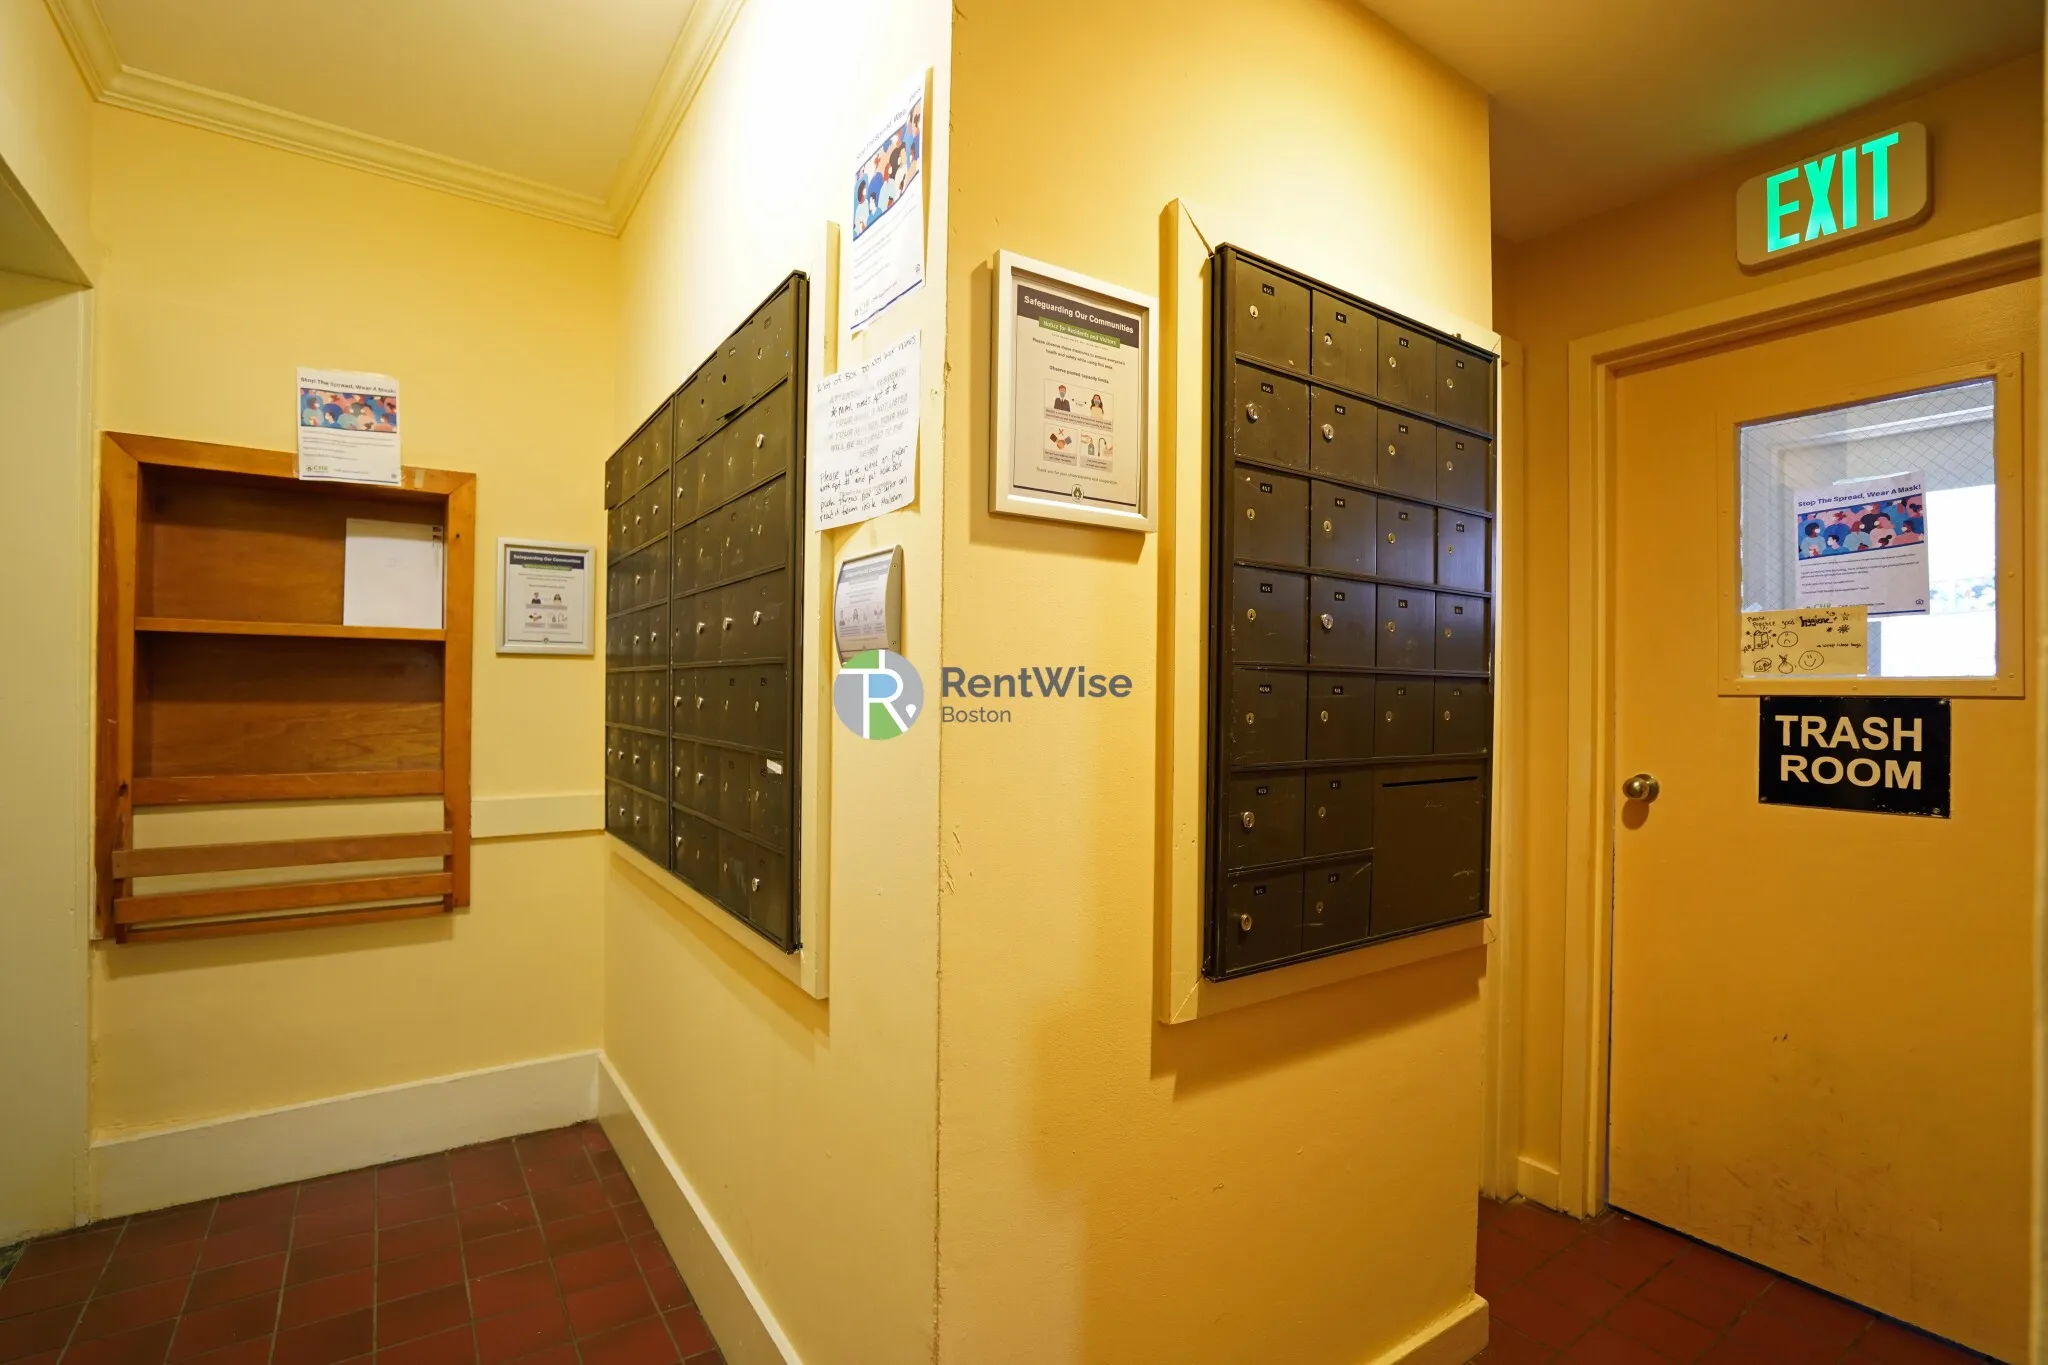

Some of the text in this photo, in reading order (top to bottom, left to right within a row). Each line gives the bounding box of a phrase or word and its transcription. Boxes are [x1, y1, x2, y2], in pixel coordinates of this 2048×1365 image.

[1767, 132, 1899, 252] EXIT
[1024, 295, 1134, 334] Safeguarding Our Communities
[1043, 320, 1059, 330] Notice
[1067, 326, 1089, 338] Residents
[1090, 332, 1099, 341] and
[1100, 335, 1118, 346] Visitors
[834, 374, 842, 386] of
[1049, 365, 1066, 374] Observe
[1798, 500, 1816, 508] Stop
[1834, 493, 1865, 503] Spread,
[1867, 490, 1890, 498] Wear
[1898, 484, 1921, 493] Mask!
[514, 554, 543, 562] Safeguarding
[1782, 620, 1795, 629] good
[1799, 616, 1832, 627] hygiene
[1774, 714, 1922, 752] TRASH
[1780, 754, 1922, 790] ROOM
